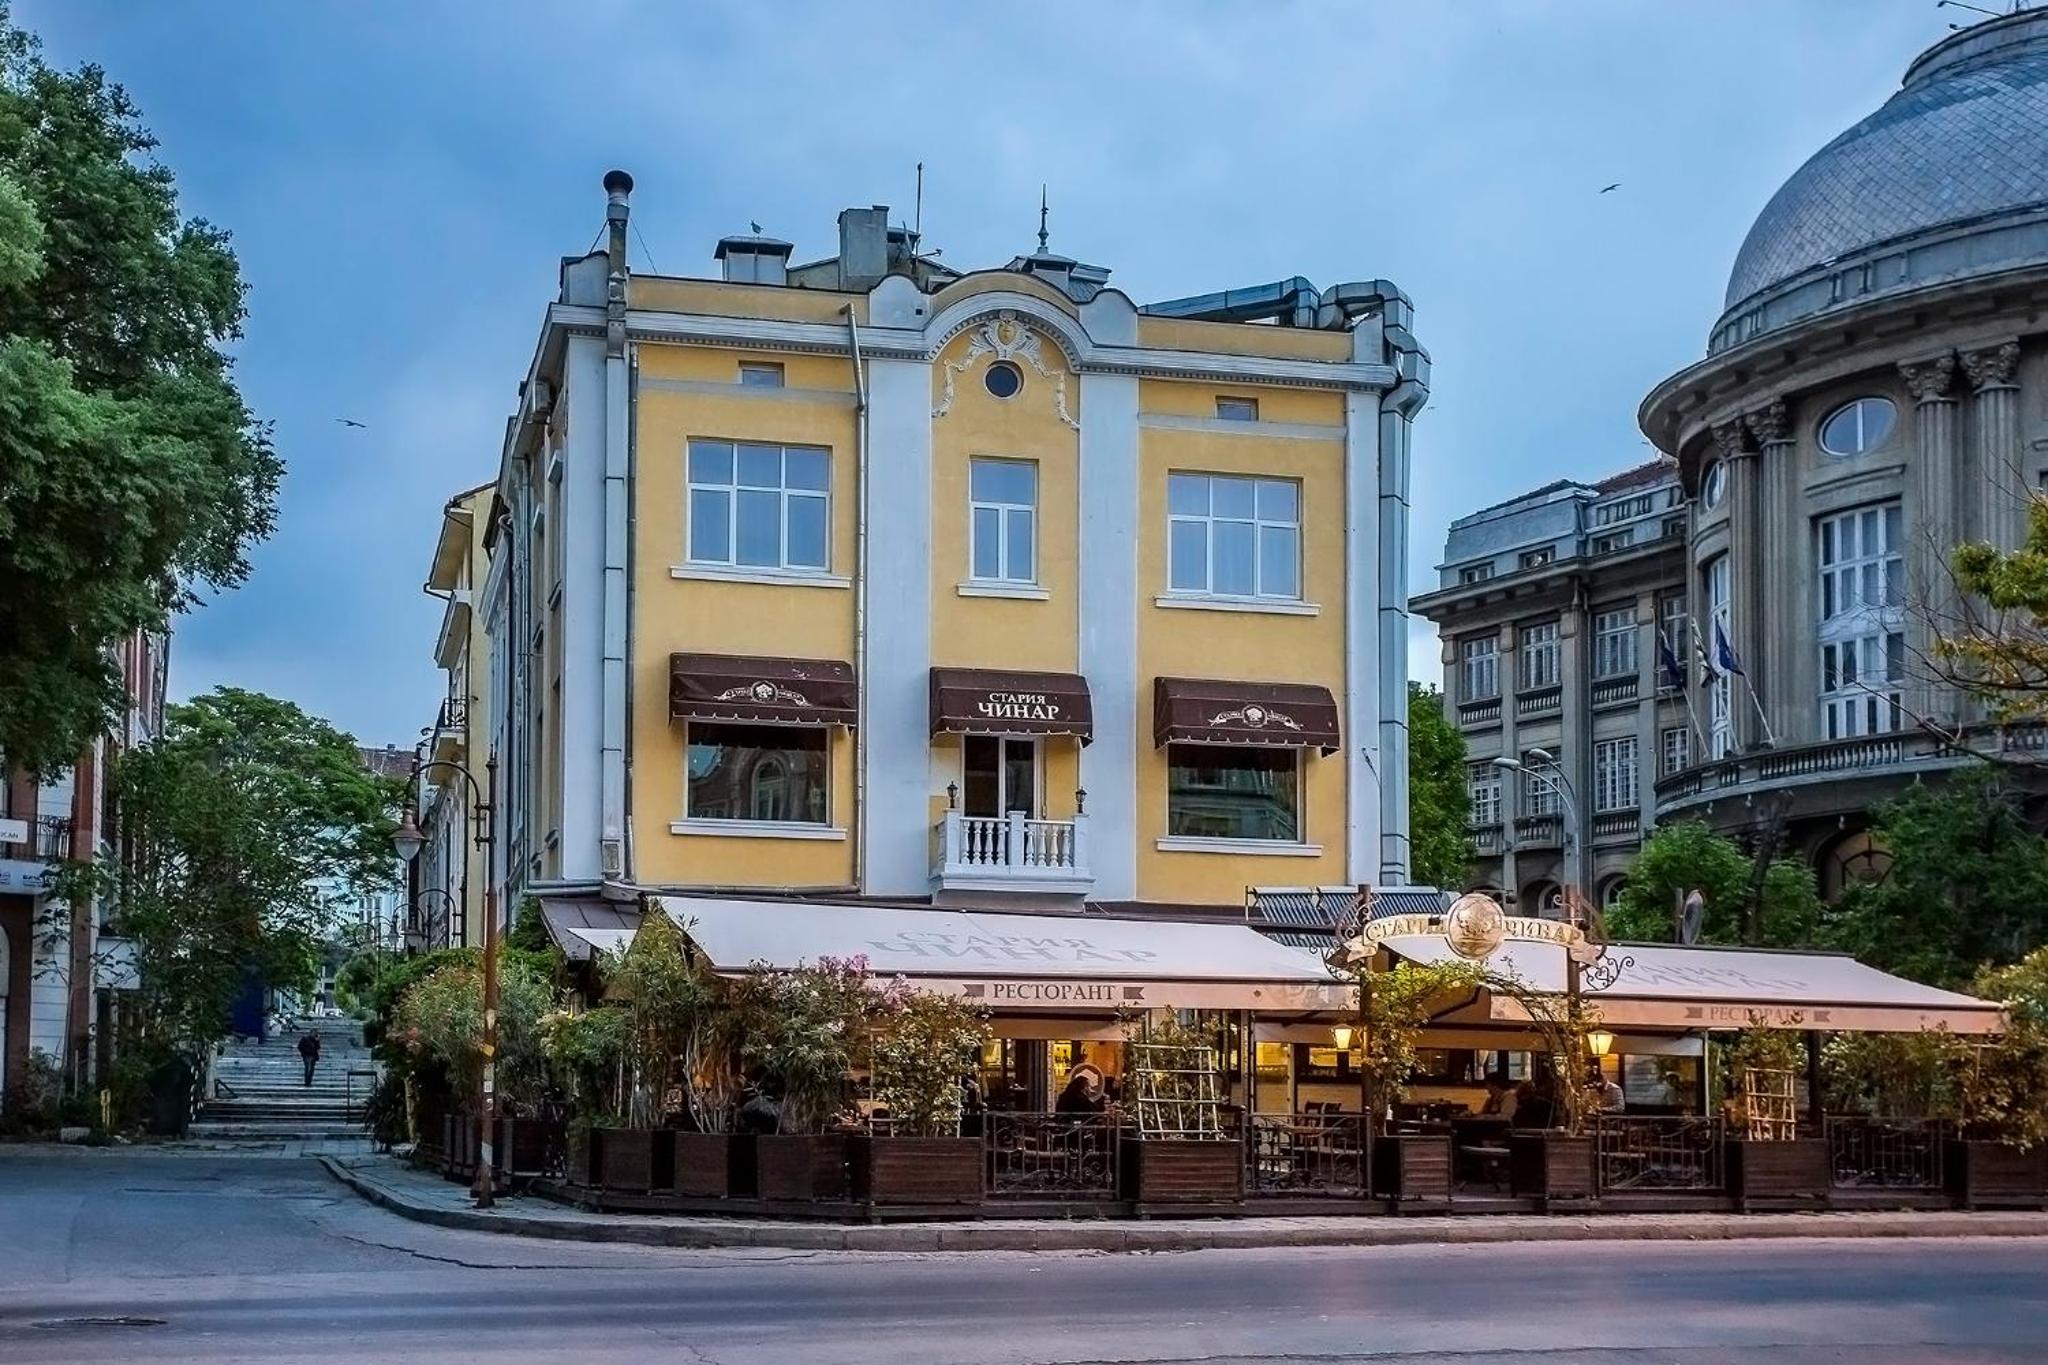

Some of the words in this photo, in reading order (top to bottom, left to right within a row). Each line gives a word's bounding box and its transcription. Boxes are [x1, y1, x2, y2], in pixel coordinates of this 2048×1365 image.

[989, 693, 1046, 705] СТАРИЯ
[978, 702, 1059, 720] ЧИНАР
[993, 983, 1116, 1001] РЕСТОРАНТ
